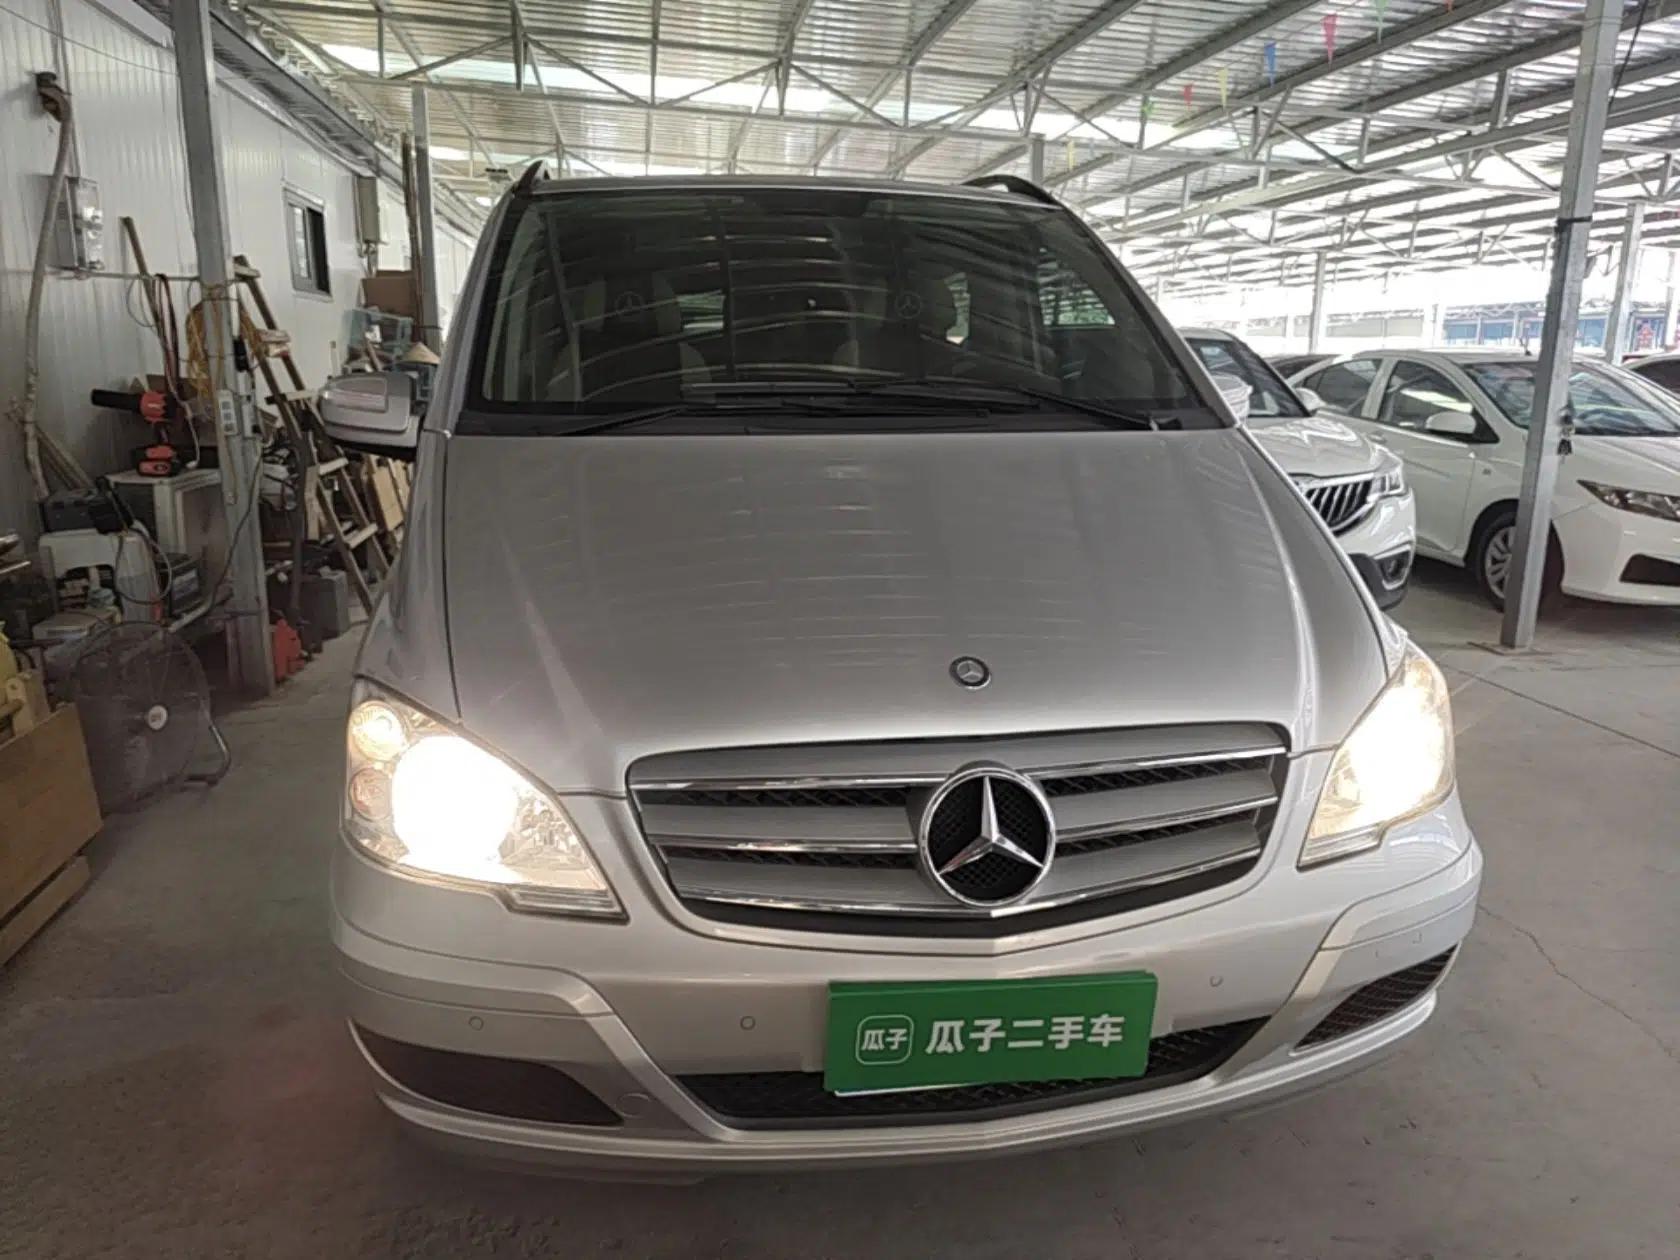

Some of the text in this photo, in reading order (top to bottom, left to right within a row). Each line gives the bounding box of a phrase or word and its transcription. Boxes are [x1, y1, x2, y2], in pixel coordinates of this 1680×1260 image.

[861, 1028, 908, 1051] 瓜子
[926, 1013, 1126, 1054] 瓜子二手车
